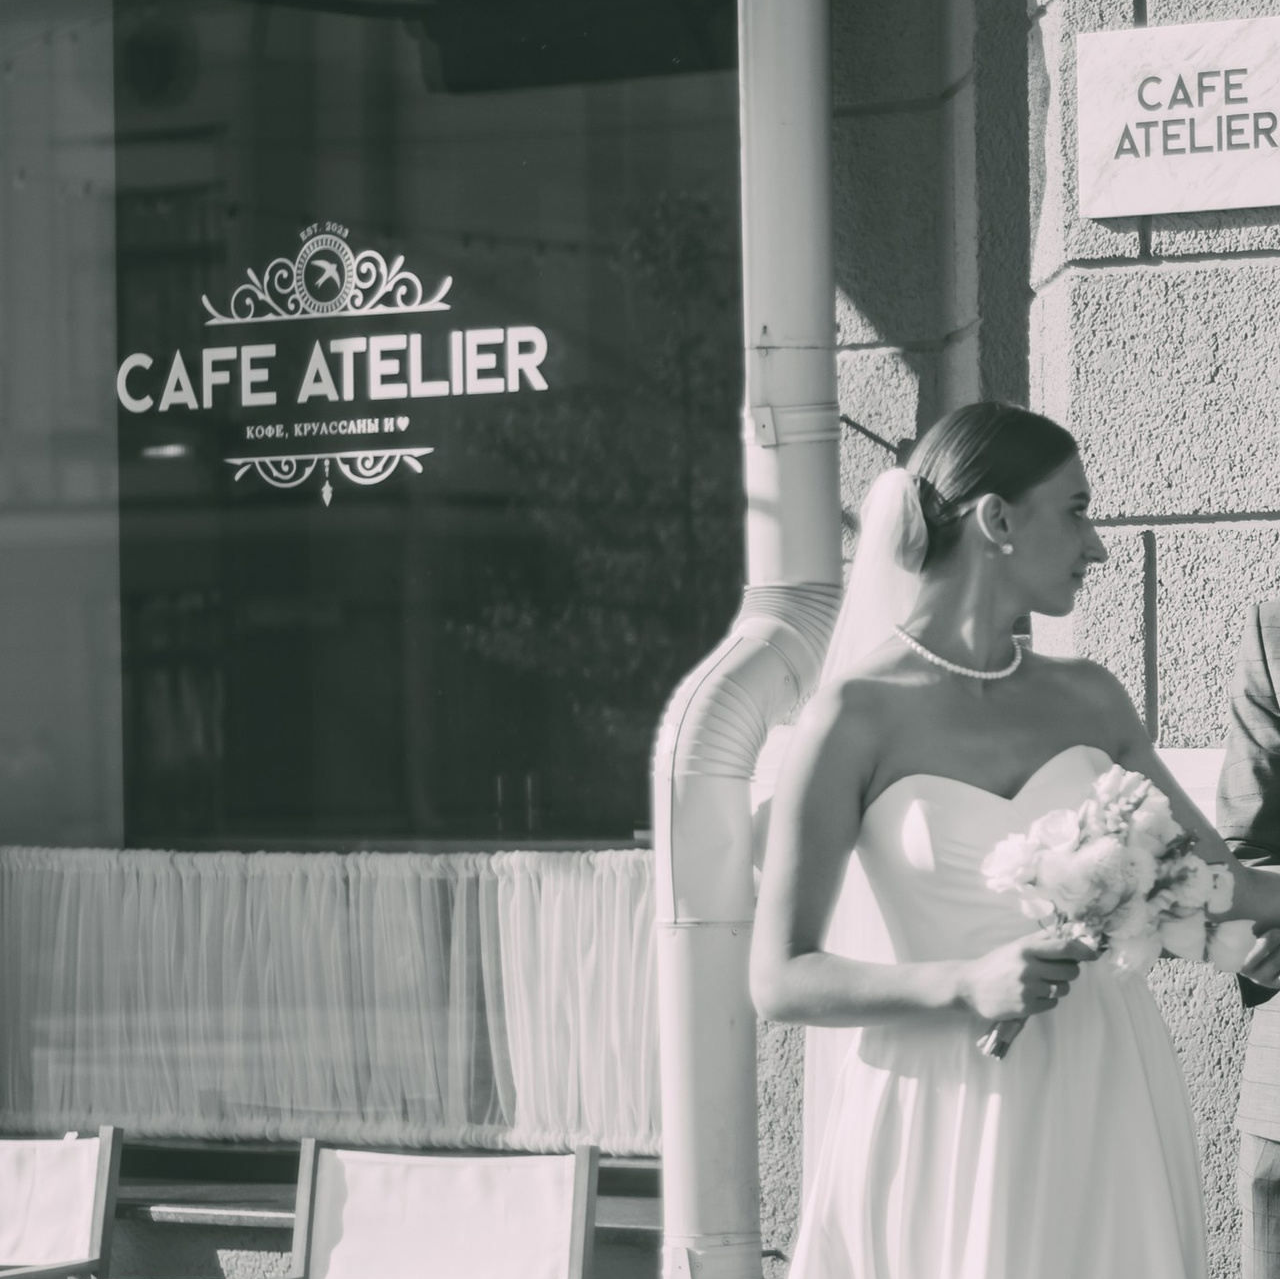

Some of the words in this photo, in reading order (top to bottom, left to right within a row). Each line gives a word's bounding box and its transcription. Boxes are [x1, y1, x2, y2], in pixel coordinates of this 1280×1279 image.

[1137, 67, 1248, 112] CAFE
[1113, 111, 1279, 160] ATELIER
[116, 343, 277, 413] CAFE
[297, 325, 549, 404] ATELIER
[246, 424, 289, 440] КОФЕ,
